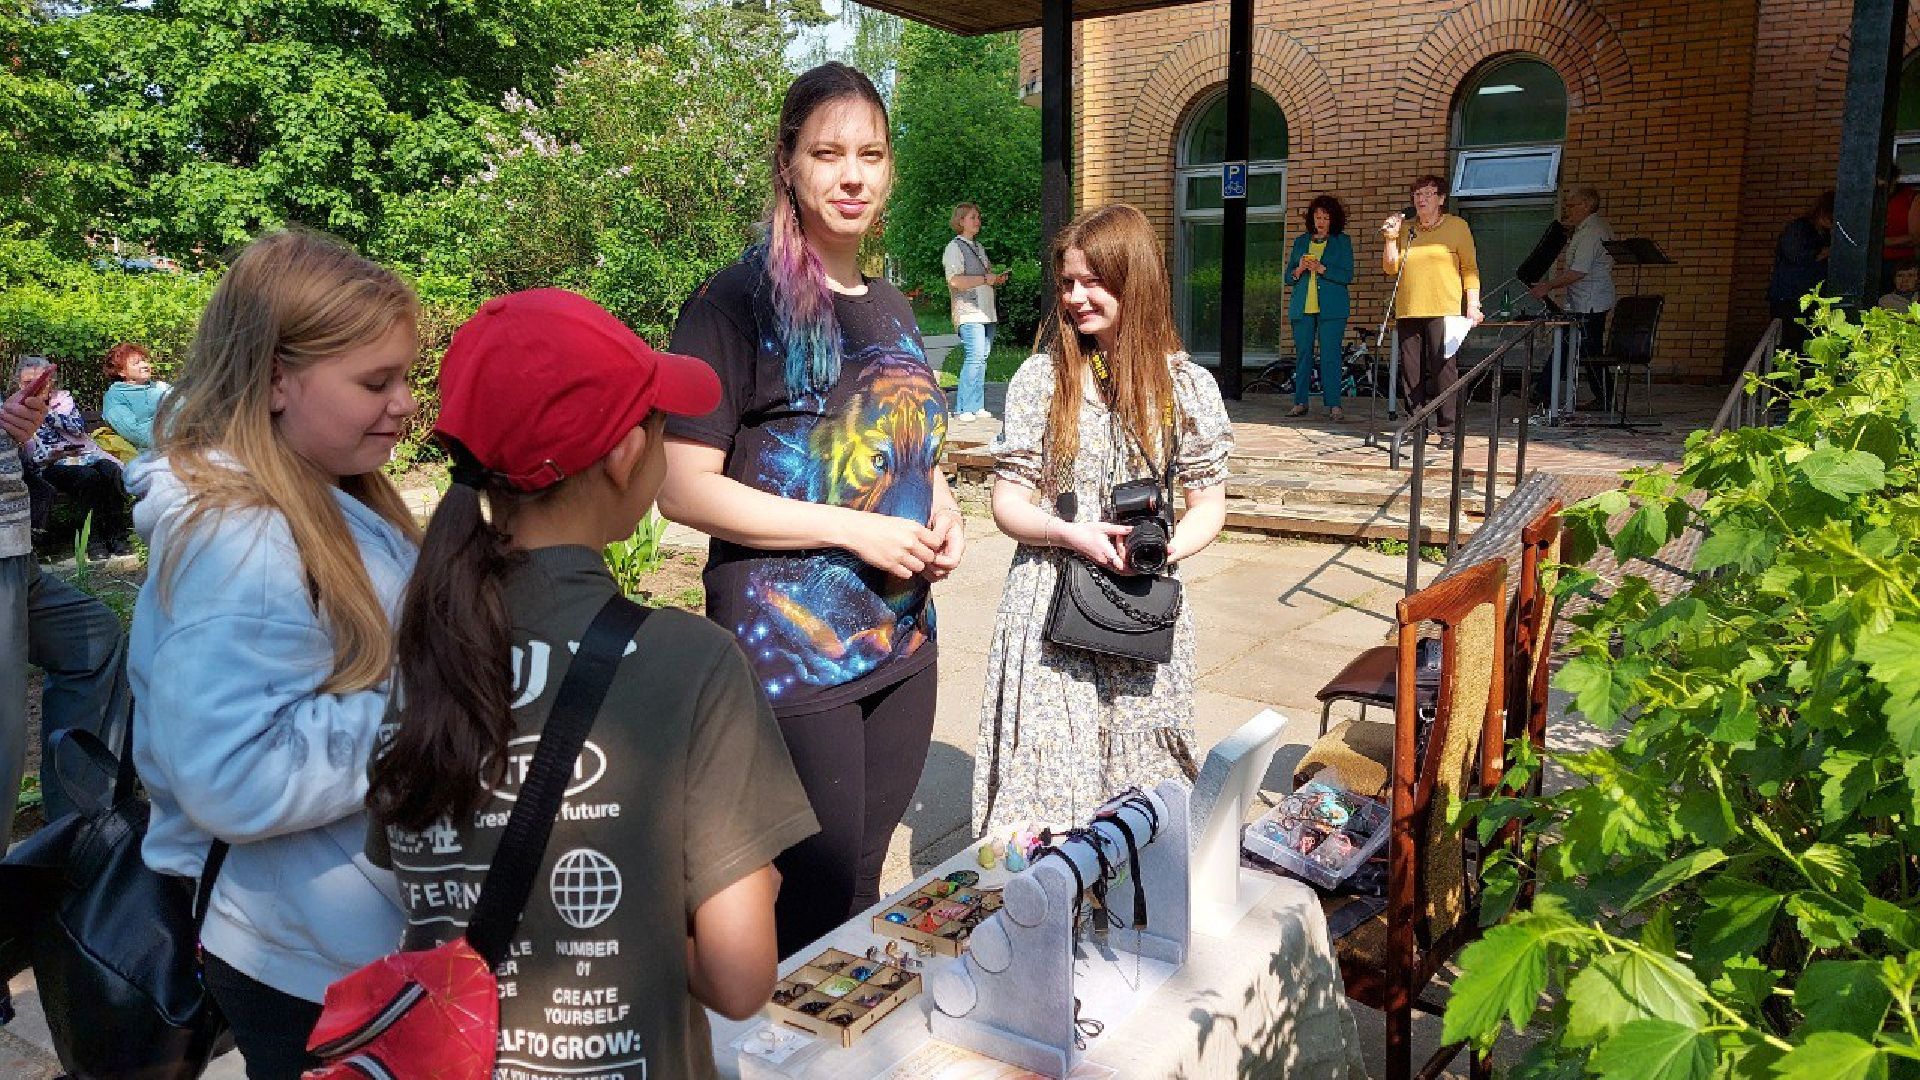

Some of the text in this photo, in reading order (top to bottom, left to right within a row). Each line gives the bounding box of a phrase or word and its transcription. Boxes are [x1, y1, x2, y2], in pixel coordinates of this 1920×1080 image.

[1229, 165, 1240, 180] P
[561, 801, 620, 820] future
[555, 940, 619, 957] NUMBER
[575, 960, 592, 976] 01
[551, 987, 618, 1006] CREATE
[543, 1004, 630, 1025] YOURSELF
[551, 1030, 641, 1060] GROW:
